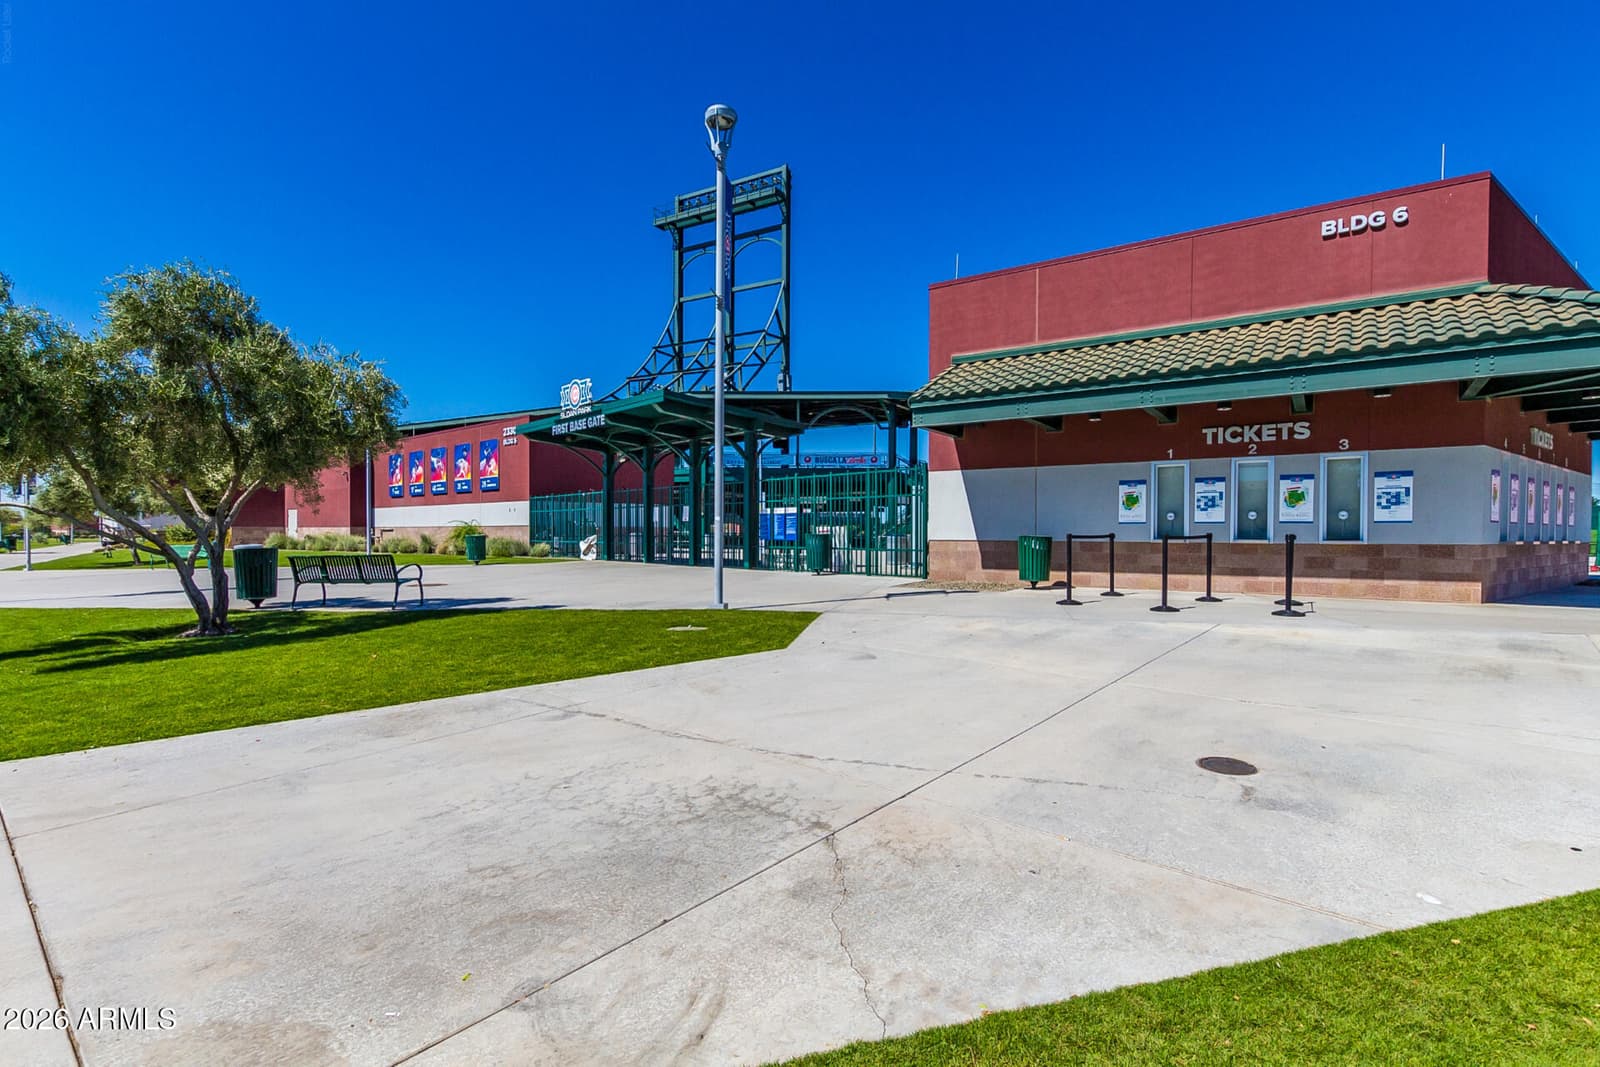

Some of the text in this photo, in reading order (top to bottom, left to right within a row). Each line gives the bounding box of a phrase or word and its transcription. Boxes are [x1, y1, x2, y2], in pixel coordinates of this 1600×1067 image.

[1321, 206, 1409, 237] BLDG 6
[560, 405, 592, 419] SLOAN PARK
[551, 414, 606, 436] FIRST BASE GATE
[1202, 421, 1312, 445] TICKETS
[1248, 444, 1258, 455] 2
[1338, 438, 1350, 450] 3
[1167, 448, 1174, 459] 1
